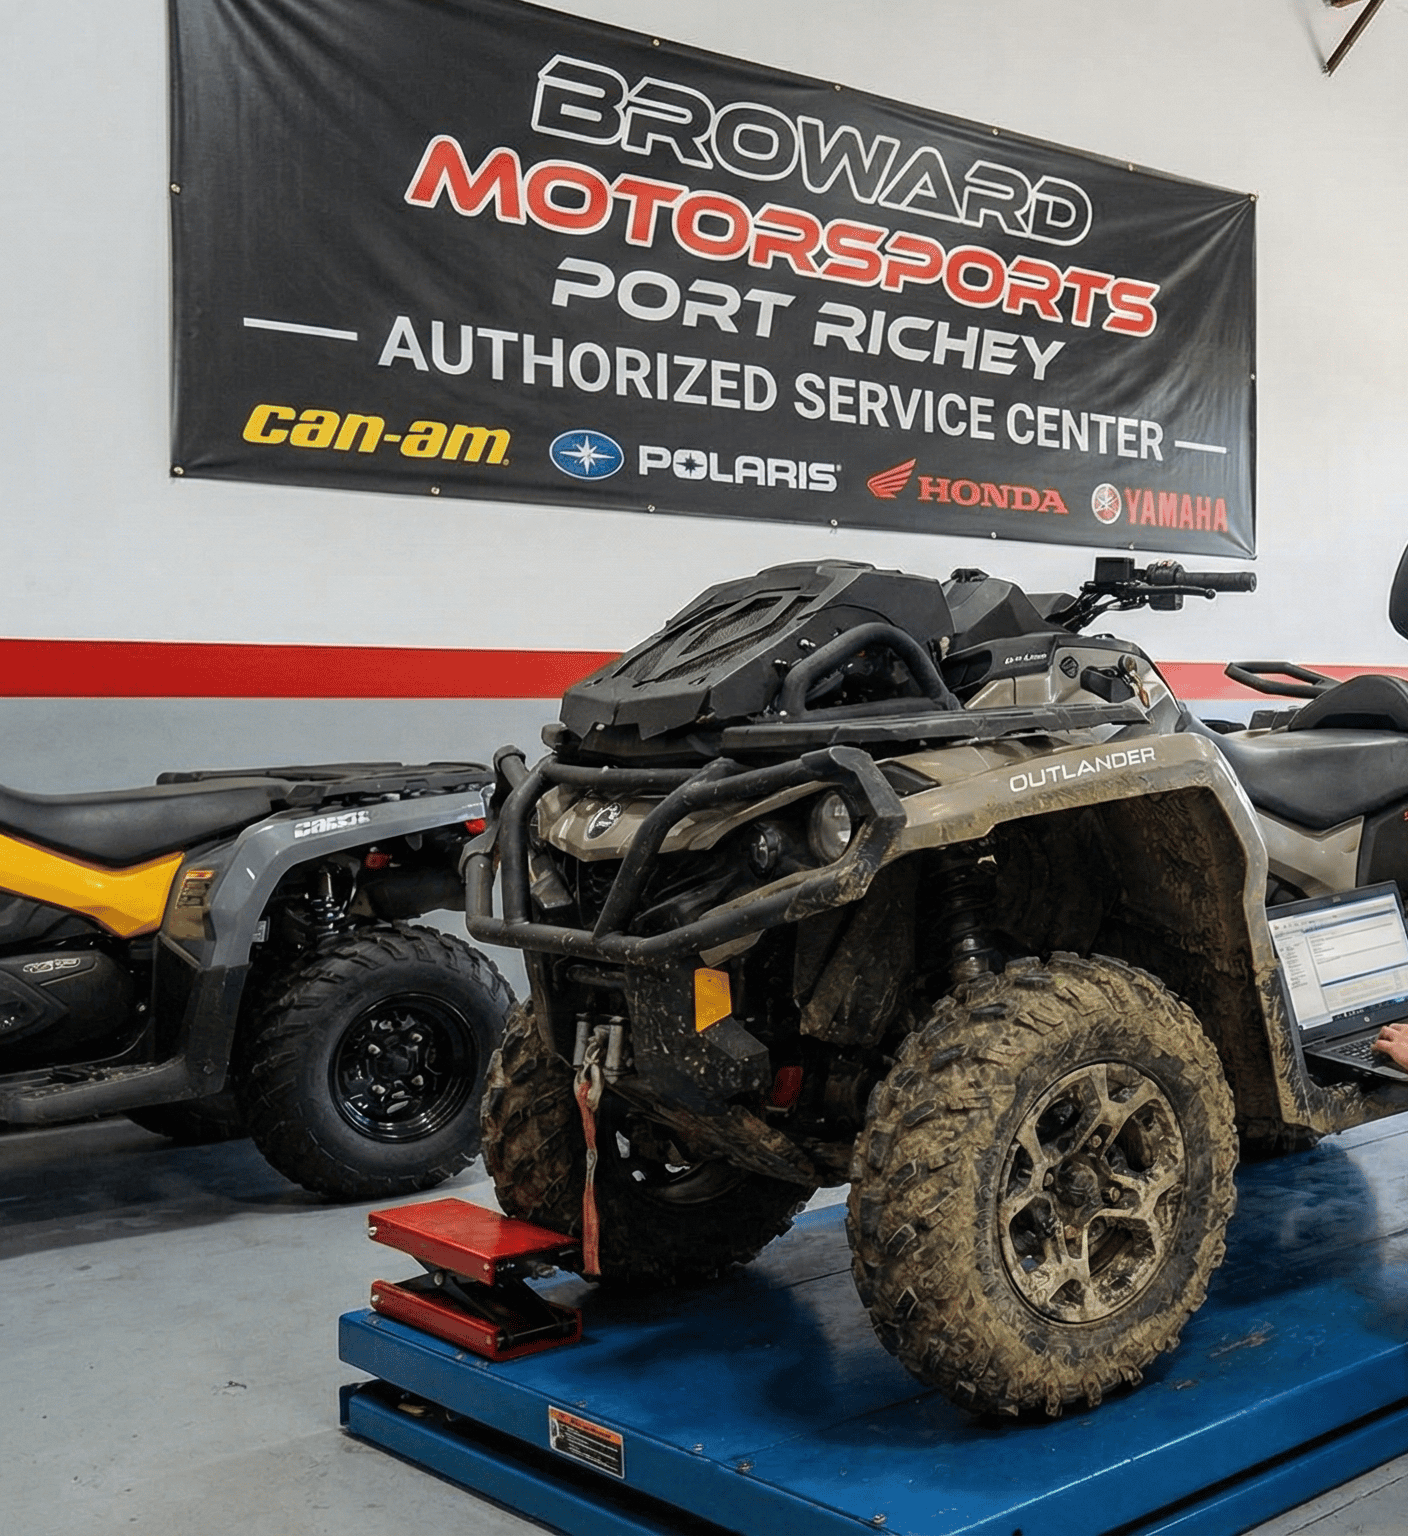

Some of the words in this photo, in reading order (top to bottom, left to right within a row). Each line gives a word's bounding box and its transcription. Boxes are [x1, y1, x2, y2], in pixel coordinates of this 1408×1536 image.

[530, 53, 1093, 247] BROWARD
[404, 134, 1161, 338] MOTORSPORTS
[551, 256, 797, 338] PORT
[813, 301, 1066, 381] RICHEY
[377, 314, 777, 412] AUTHORIZED
[793, 372, 996, 442] SERVICE
[1006, 402, 1164, 461] CENTER
[242, 403, 512, 466] can-am
[638, 444, 841, 493] POLARIS
[917, 475, 1070, 515] HONDA
[1124, 487, 1229, 532] YAMAHA
[1009, 746, 1157, 793] OUTLANDER
